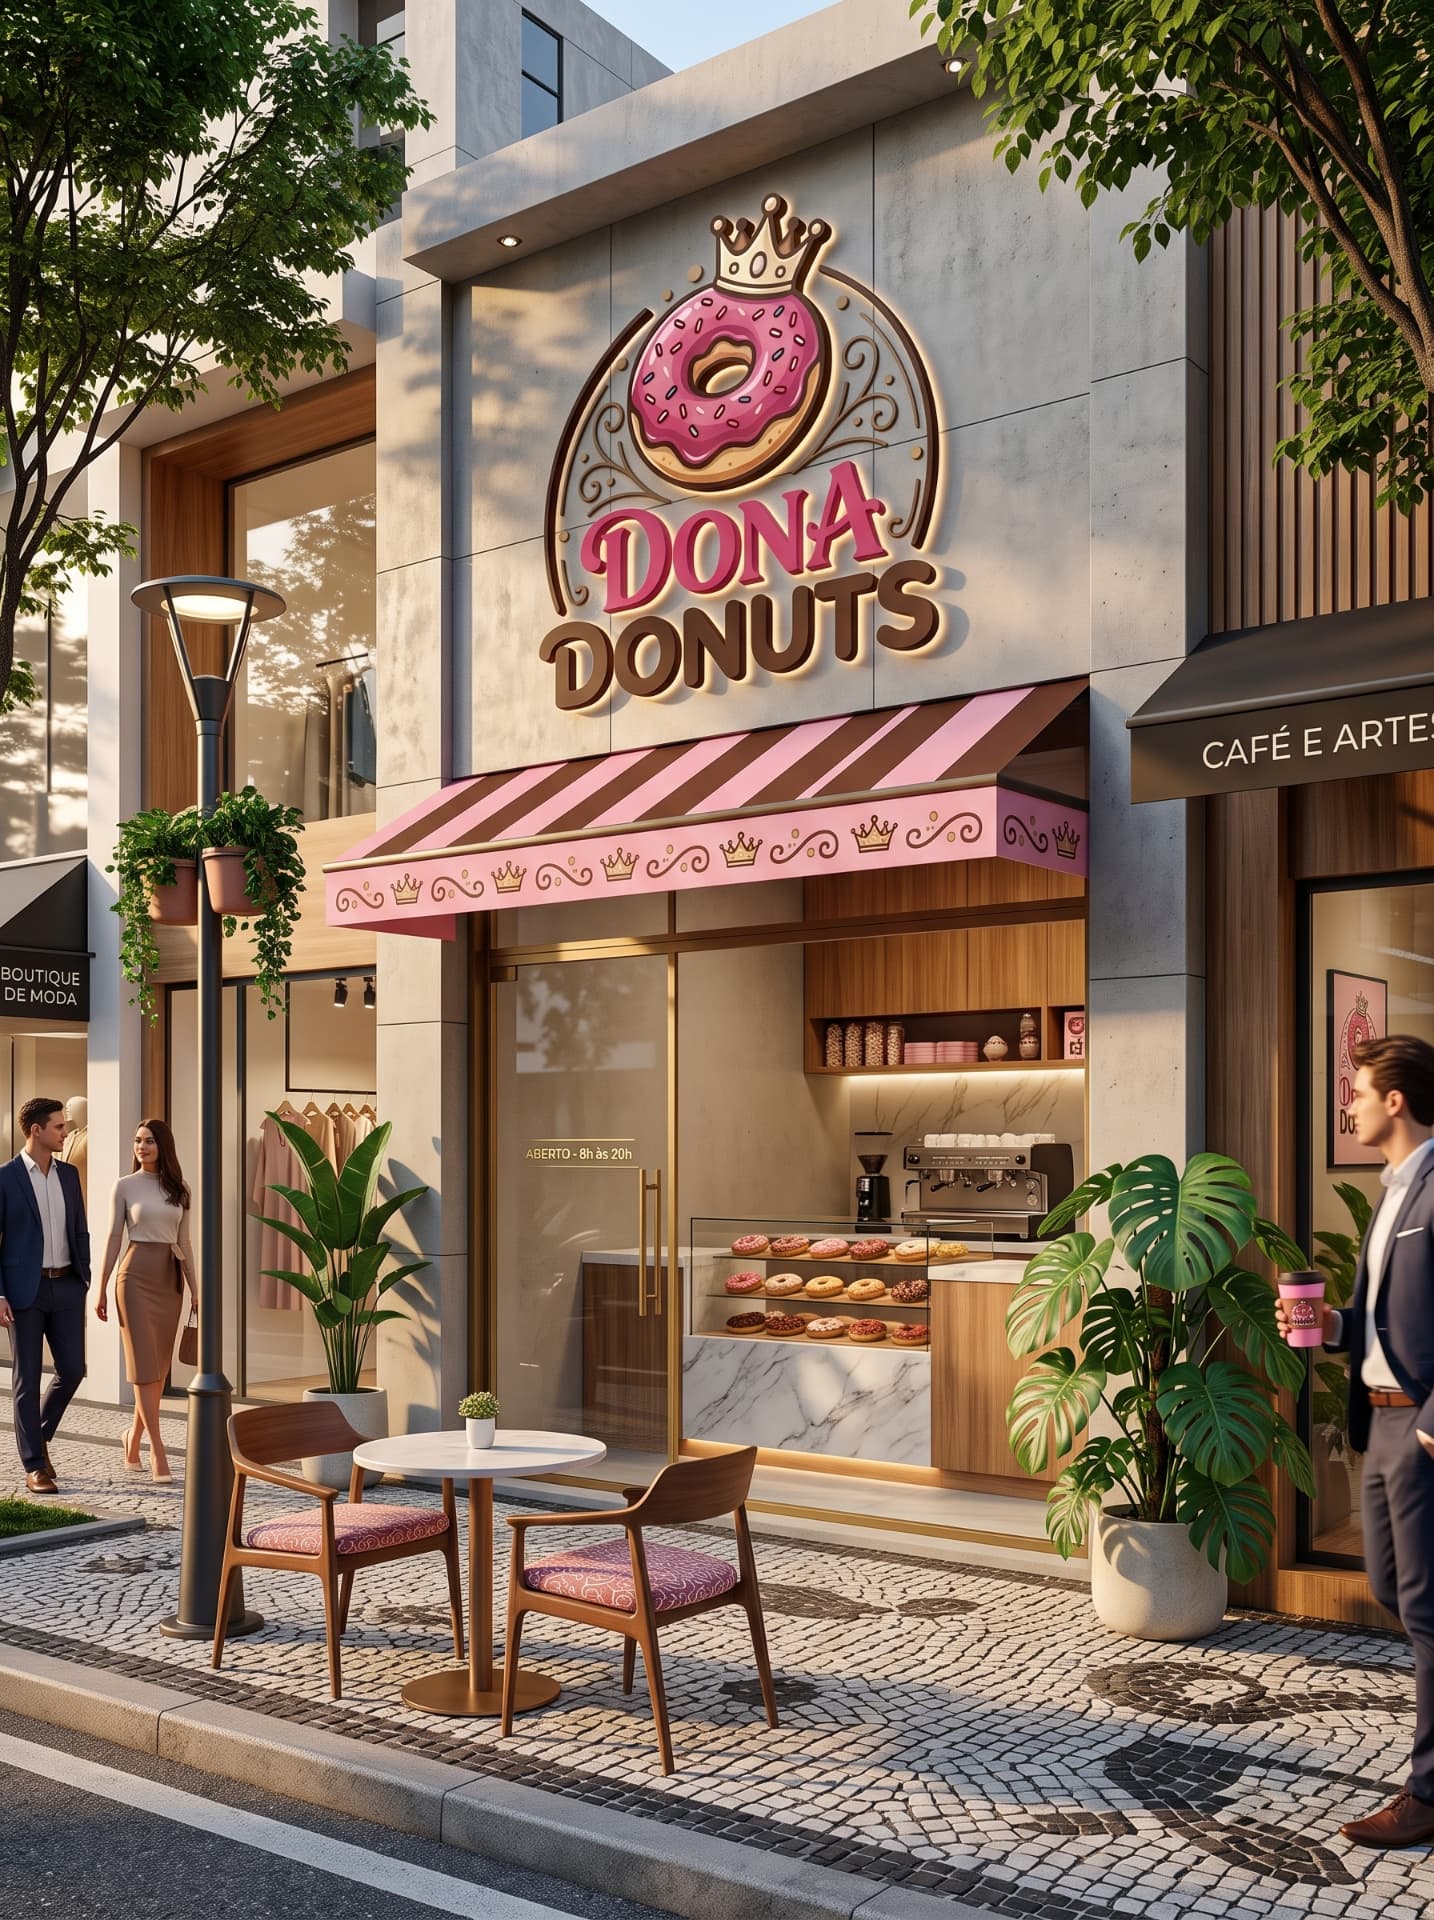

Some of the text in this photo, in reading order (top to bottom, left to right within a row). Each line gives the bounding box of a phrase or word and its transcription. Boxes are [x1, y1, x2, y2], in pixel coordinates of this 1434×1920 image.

[581, 460, 888, 613] DONA
[539, 559, 940, 711] DONUTS
[1202, 712, 1434, 769] CAFÉ E ARTE
[1, 966, 80, 987] BOUTIQUE
[4, 987, 77, 1006] DE MODA
[526, 1148, 571, 1160] ABERTO
[579, 1148, 593, 1159] 8h
[595, 1147, 608, 1160] às
[611, 1147, 632, 1160] 20h
